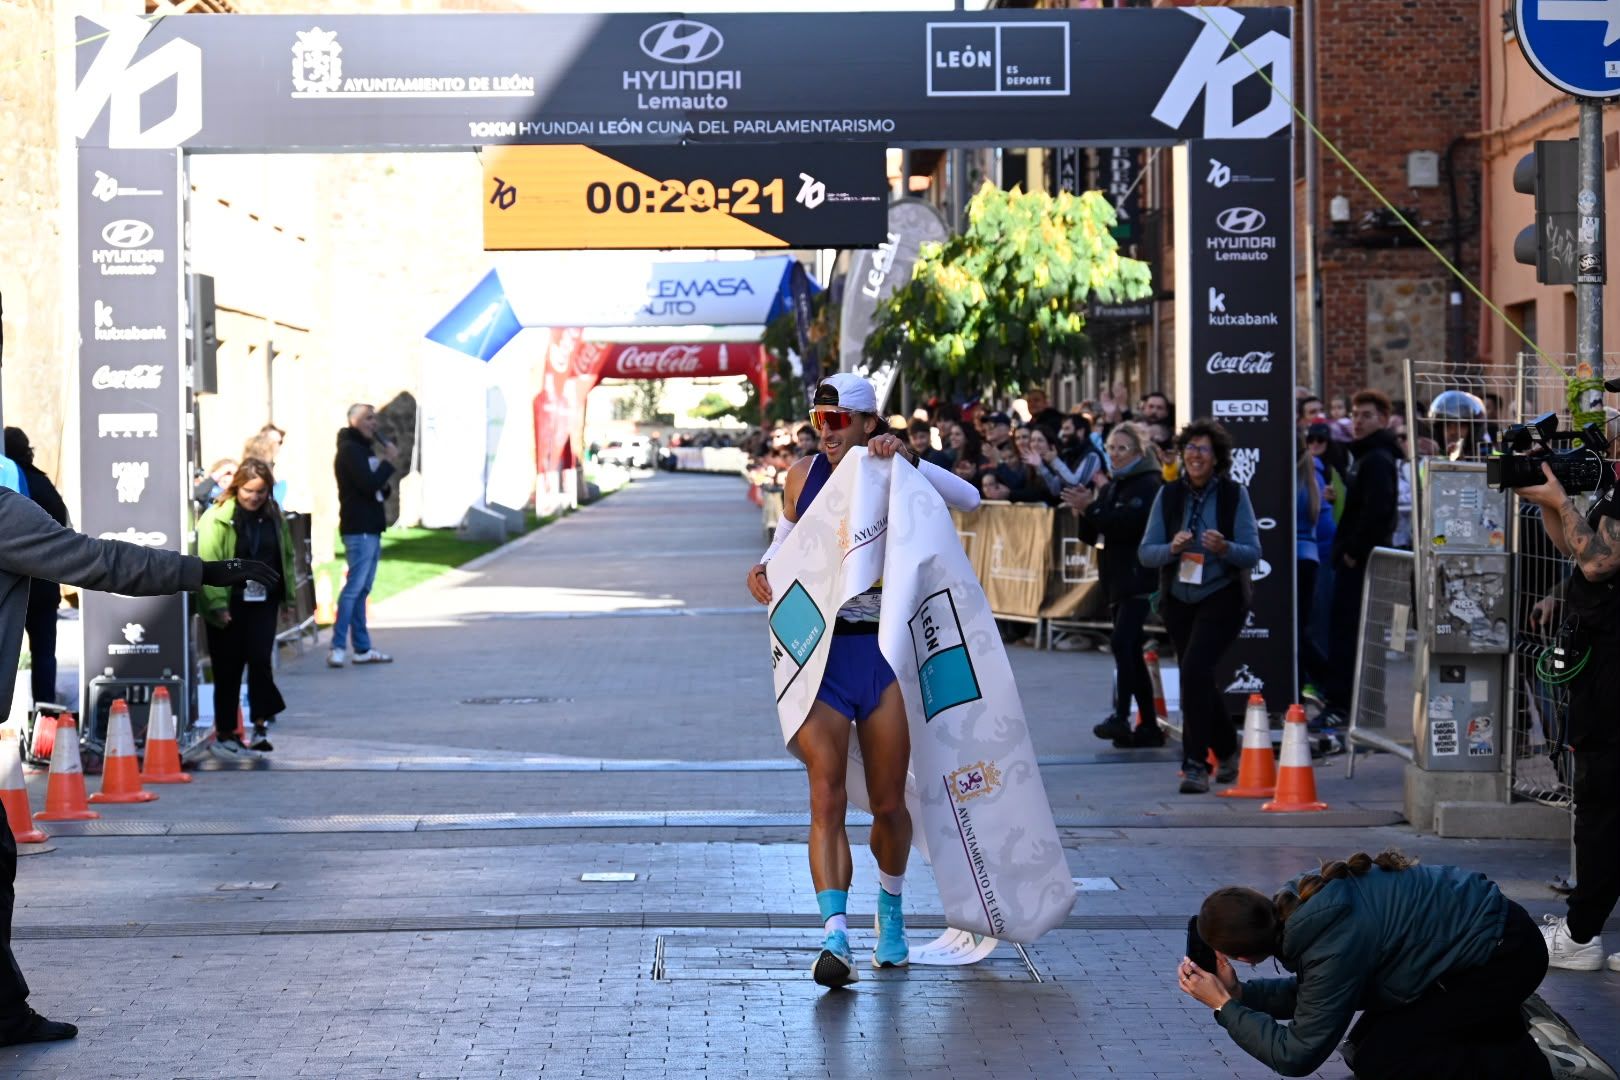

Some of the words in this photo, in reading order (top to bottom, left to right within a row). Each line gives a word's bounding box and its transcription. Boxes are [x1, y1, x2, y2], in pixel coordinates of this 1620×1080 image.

[936, 45, 991, 68] LEÓN
[1006, 65, 1019, 74] ES
[343, 77, 466, 92] AYUNTAMIENTO
[468, 77, 489, 91] DE
[493, 73, 535, 90] LEÓN
[622, 70, 742, 90] HYUNDAI
[1006, 76, 1051, 85] DEPORTE
[637, 93, 728, 109] Lemauto
[469, 121, 516, 137] 10KM
[519, 121, 594, 135] HYUNDAI
[599, 117, 643, 134] LEÓN
[647, 120, 694, 134] CUNA
[699, 120, 729, 134] DEL
[733, 118, 896, 133] PARLAMENTARISMO
[586, 178, 784, 214] 00:29:21
[1206, 236, 1276, 249] HYUNDAI
[93, 250, 164, 263] HYUNDAI
[1215, 250, 1268, 261] Lemauto
[1209, 313, 1278, 326] kutxabank
[1215, 402, 1267, 413] LEON
[920, 606, 940, 652] LEÓN
[791, 639, 800, 650] ES
[797, 625, 819, 657] DEPORTE
[958, 806, 991, 889] AYUNTAMIENTO
[984, 889, 996, 906] DE
[990, 907, 1006, 935] LEÓN
